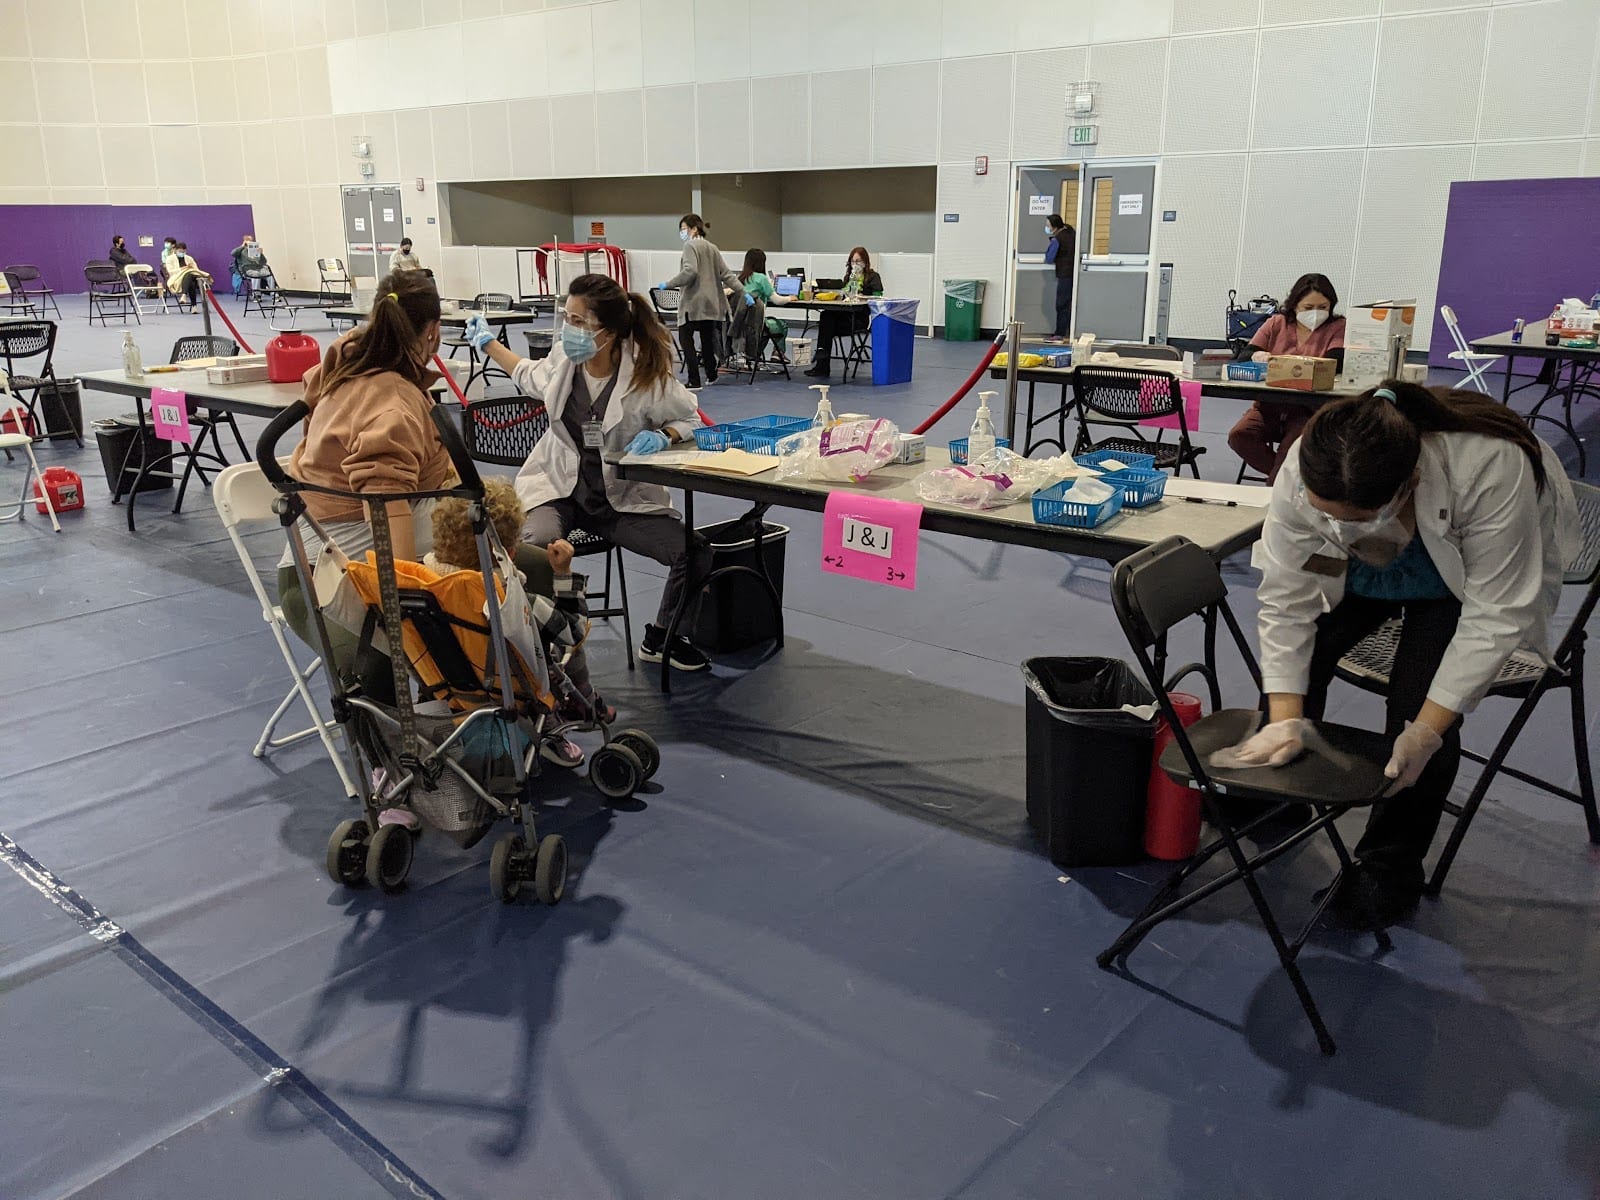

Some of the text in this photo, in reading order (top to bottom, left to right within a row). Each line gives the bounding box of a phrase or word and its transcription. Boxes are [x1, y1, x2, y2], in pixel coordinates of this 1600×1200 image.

[1074, 127, 1091, 142] EXIT
[847, 524, 889, 550] J & J
[835, 555, 844, 568] 2
[886, 566, 895, 581] 3
